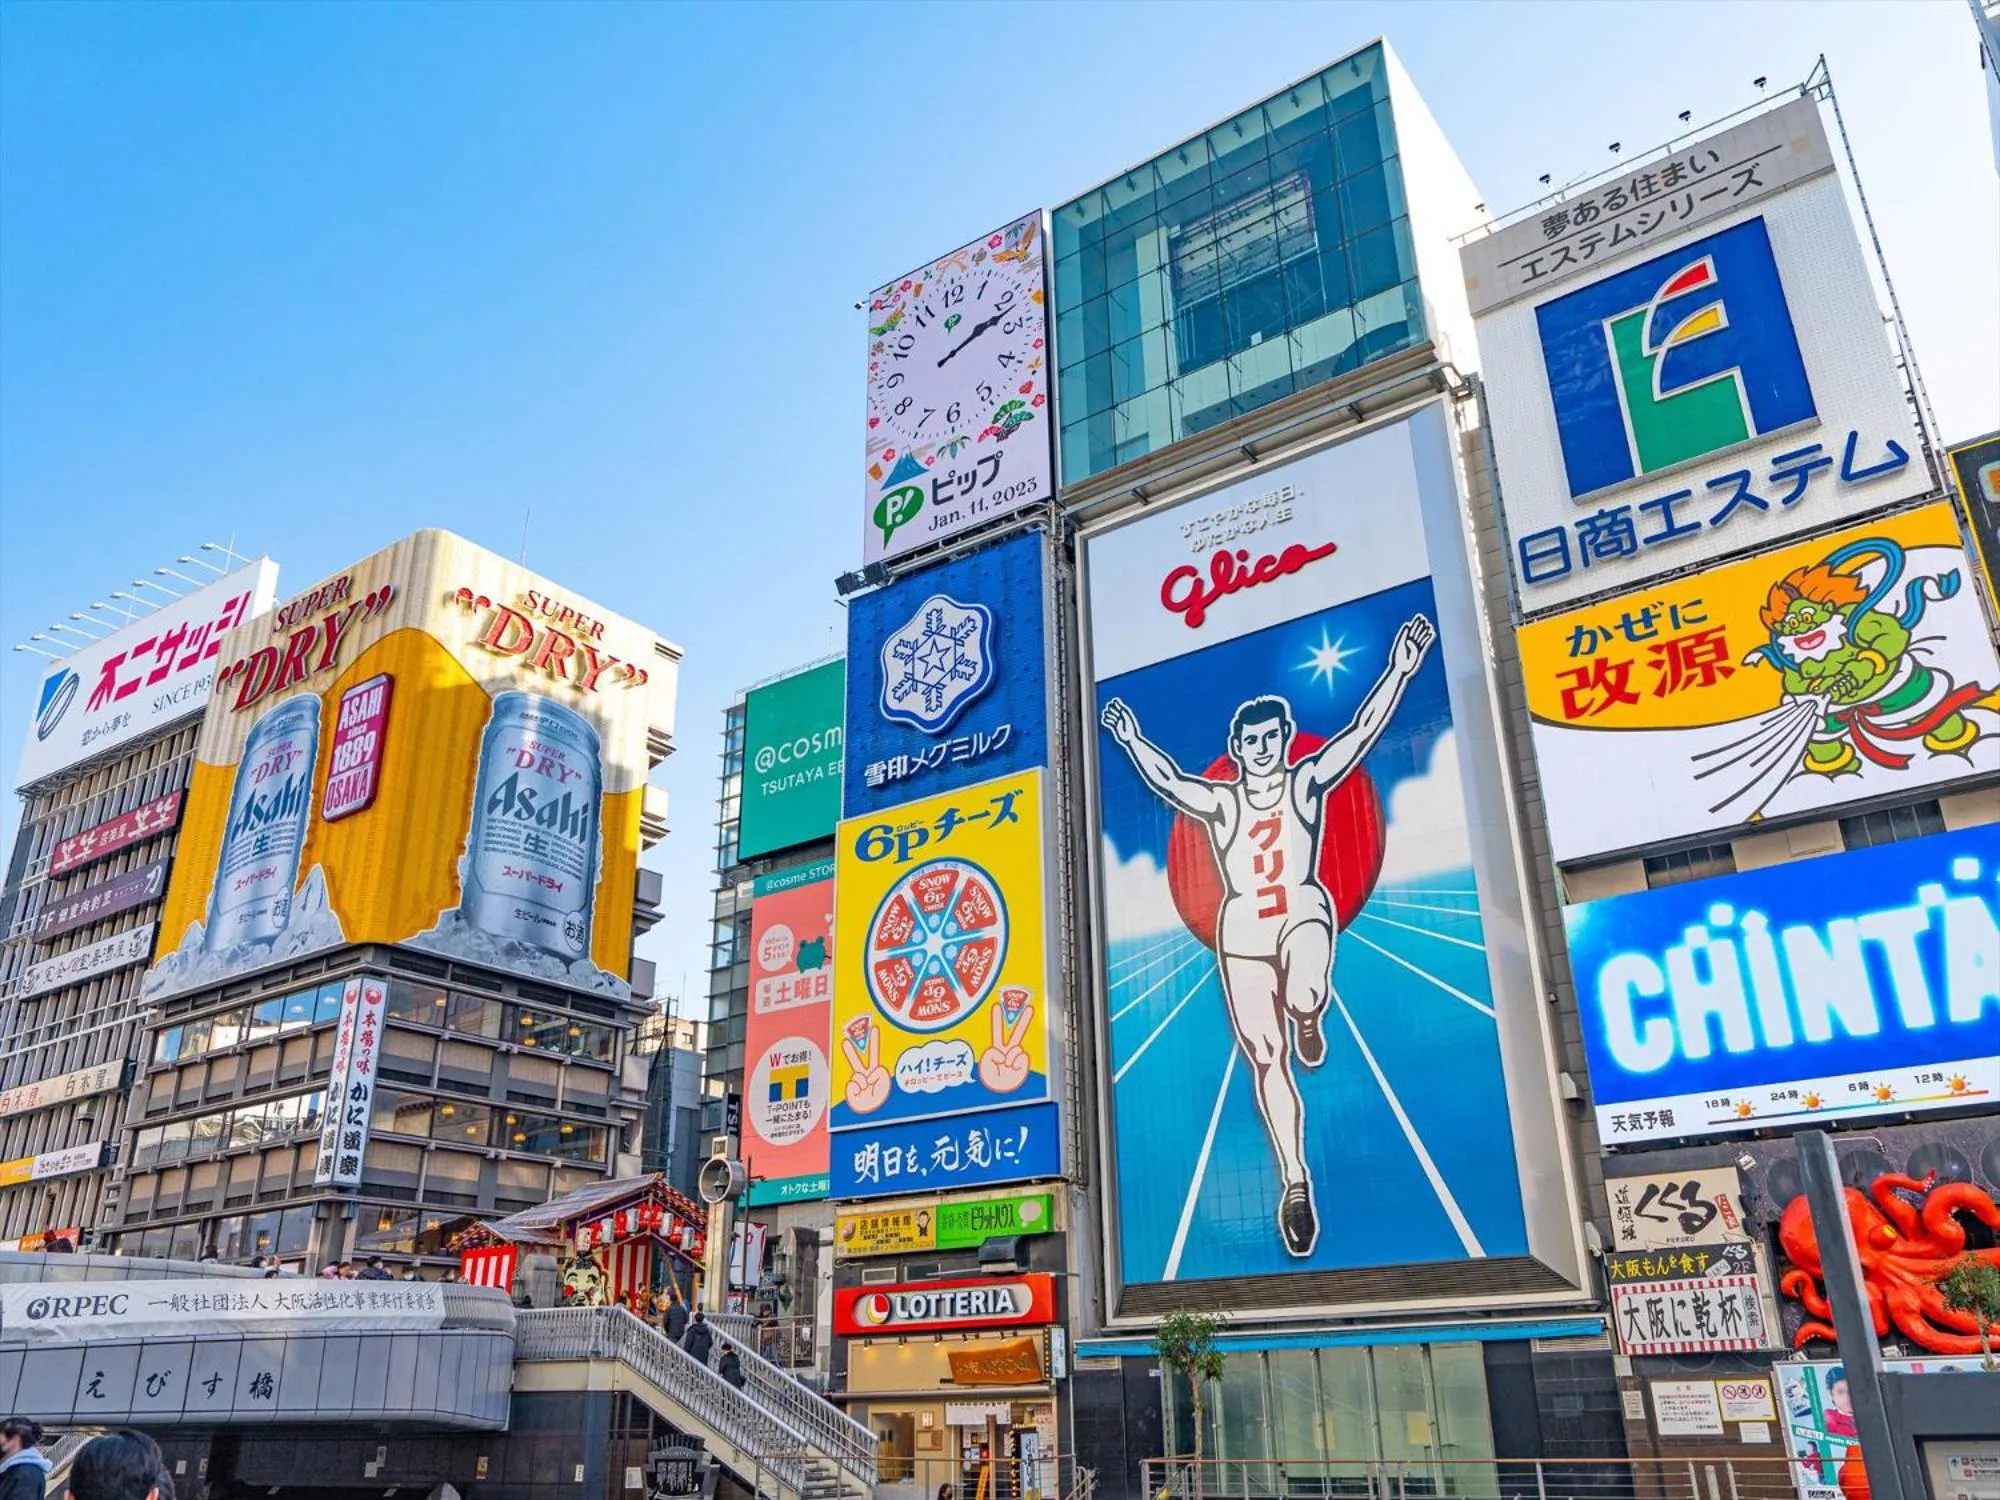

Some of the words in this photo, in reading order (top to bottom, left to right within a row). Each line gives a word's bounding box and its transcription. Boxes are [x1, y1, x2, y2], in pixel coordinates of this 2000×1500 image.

[1540, 149, 1720, 241] 夢ある住まい
[1521, 162, 1764, 284] エステムシリーズ
[943, 284, 965, 308] 12
[976, 280, 988, 300] 1
[994, 290, 1014, 312] 2
[914, 305, 936, 328] 11
[1003, 316, 1023, 335] 3
[893, 334, 915, 361] 10
[997, 350, 1016, 369] 4
[886, 372, 905, 389] 9
[976, 380, 993, 402] 5
[894, 396, 913, 416] 8
[918, 408, 936, 428] 7
[946, 401, 961, 423] 6
[931, 450, 1004, 506] ピップ
[928, 510, 966, 532] Jan.
[992, 477, 1038, 507] 2023
[1518, 430, 1910, 585] 日商エステム
[1192, 507, 1294, 553] ゆたかな人生
[274, 575, 350, 633] SUPER
[524, 589, 606, 641] SUPER
[1565, 599, 1709, 658] かぜに
[1555, 624, 1736, 720] 改源
[151, 681, 193, 715] SINCE
[339, 685, 384, 732] ASAHI
[333, 730, 377, 775] 1889
[529, 739, 566, 762] SUPER
[864, 724, 1011, 788] 雪印メグミルク
[326, 768, 369, 813] OSAKA
[761, 765, 825, 797] TSUTAYA
[231, 771, 305, 842] Asahi
[487, 771, 589, 844] Asahi
[252, 833, 271, 857] 生
[524, 832, 549, 858] 生
[502, 864, 564, 893] スーパードライ
[1247, 809, 1288, 920] グリコ
[765, 872, 807, 891] @cosme
[919, 872, 951, 890] SNOW
[970, 886, 994, 919] SNOW
[879, 903, 900, 942] SNOW
[970, 946, 993, 987] SNOW
[774, 974, 828, 1005] 土曜日
[879, 969, 900, 1002] SNOW
[917, 1001, 950, 1017] SNOW
[1913, 1072, 1944, 1085] 12時
[1705, 1098, 1731, 1110] 18時
[1770, 1089, 1799, 1102] 24時
[1611, 1108, 1676, 1134] 天気予報
[781, 1179, 831, 1196] オトクな土曜
[1634, 1180, 1718, 1235] くくる
[1610, 1252, 1710, 1279] 大阪もんを食す
[1733, 1261, 1751, 1274] 2F
[895, 1288, 1015, 1320] LOTTERIA
[1623, 1291, 1742, 1342] 大阪に乾杯
[86, 1370, 275, 1401] えびす橋
